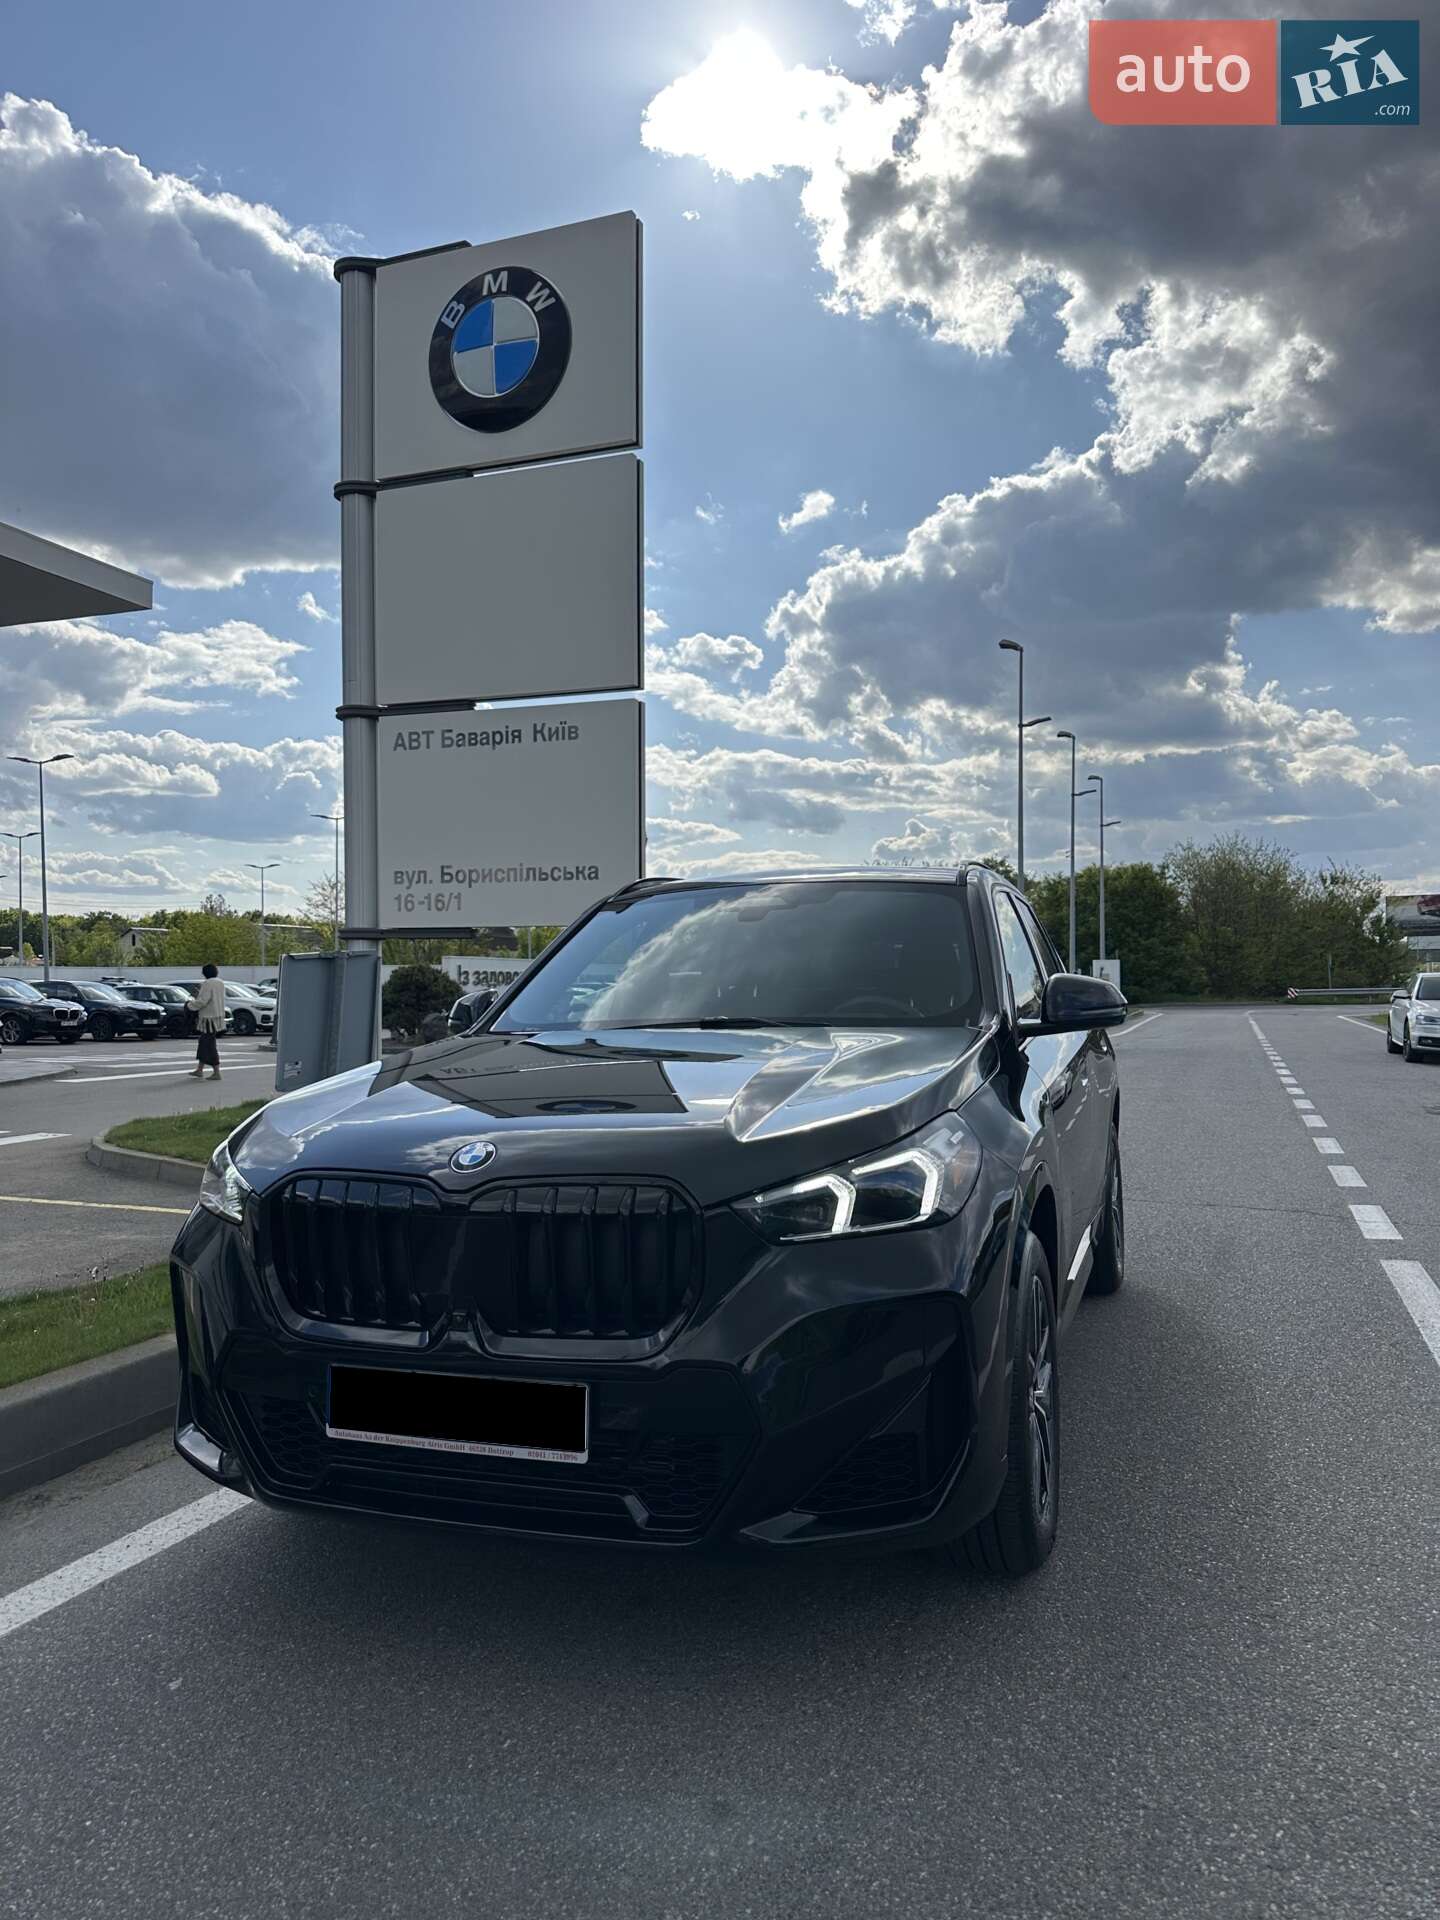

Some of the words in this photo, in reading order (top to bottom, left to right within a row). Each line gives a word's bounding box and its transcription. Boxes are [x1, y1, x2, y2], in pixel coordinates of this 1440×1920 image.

[440, 270, 556, 329] BMW
[393, 730, 434, 751] АВТ
[441, 725, 522, 750] Баварія
[533, 721, 579, 743] Київ
[393, 868, 433, 890] вул.
[440, 863, 599, 888] Бориспільська
[393, 892, 462, 912] 16-16/1
